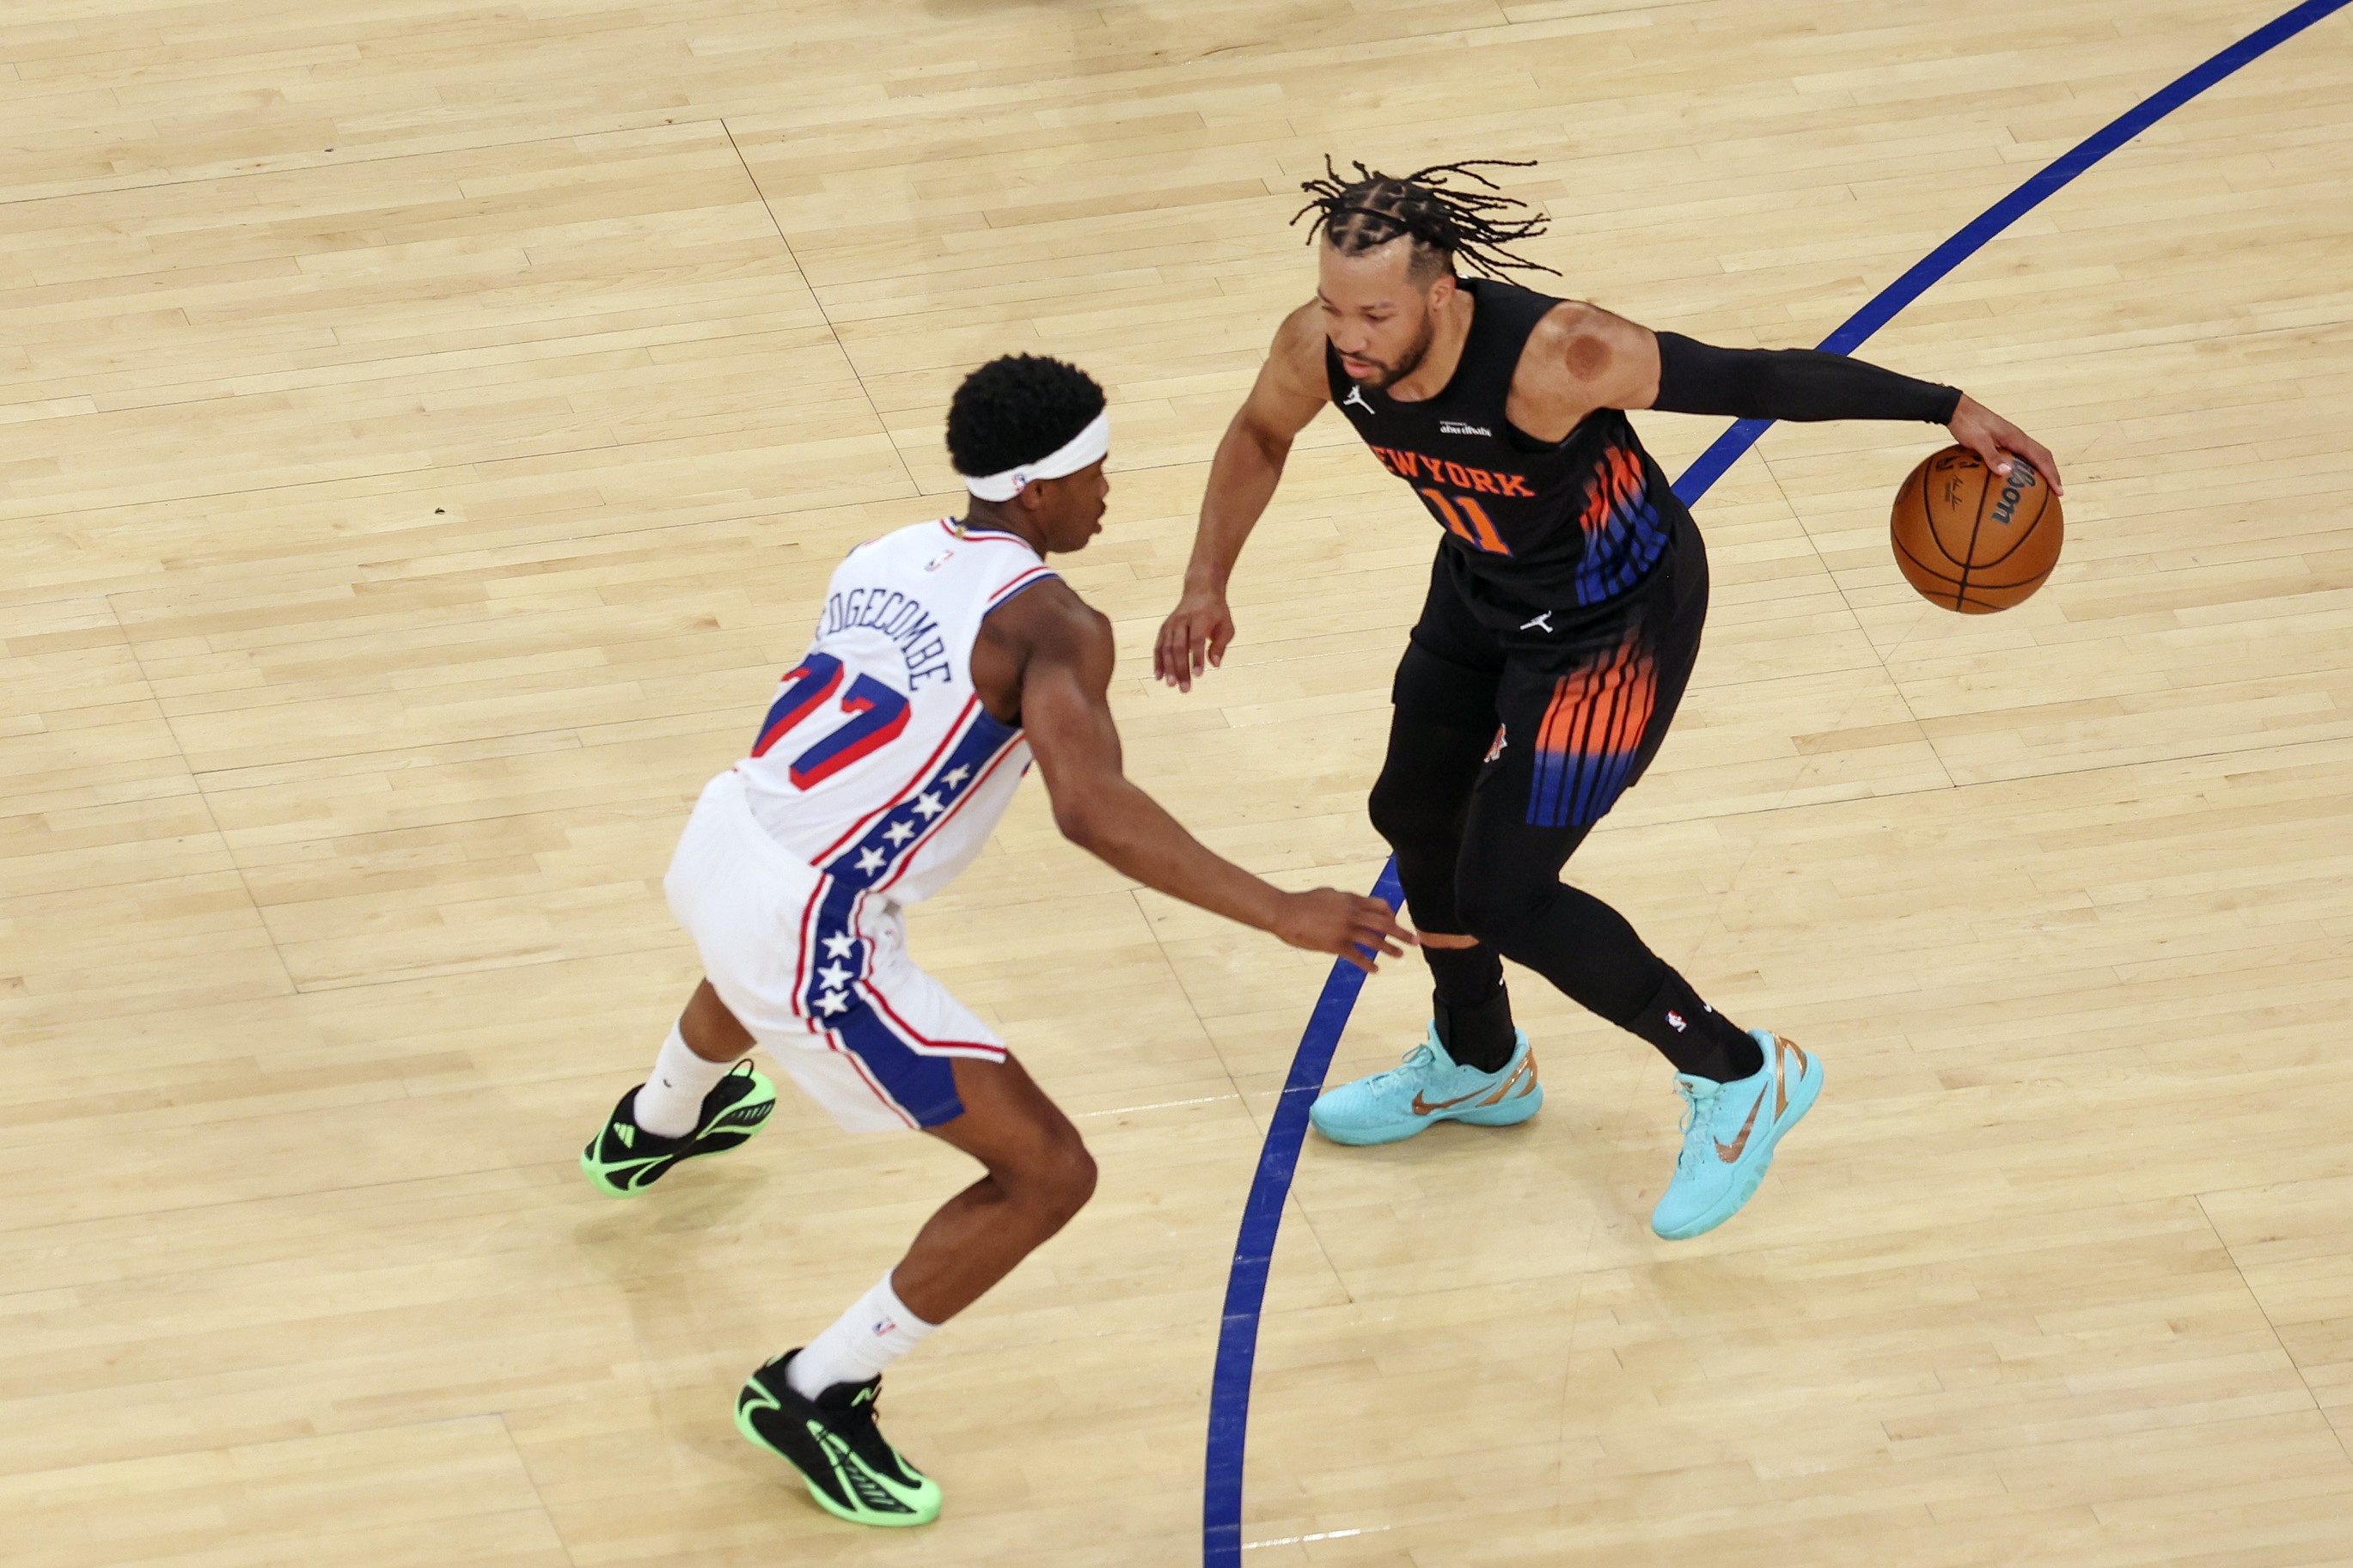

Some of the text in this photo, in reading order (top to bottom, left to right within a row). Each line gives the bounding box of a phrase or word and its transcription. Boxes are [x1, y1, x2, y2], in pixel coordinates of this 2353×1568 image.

[1418, 454, 1536, 497] YORK
[1991, 459, 2037, 527] ilson
[1418, 486, 1513, 558] 11
[816, 588, 952, 692] DGECOMBE
[750, 651, 912, 792] 77
